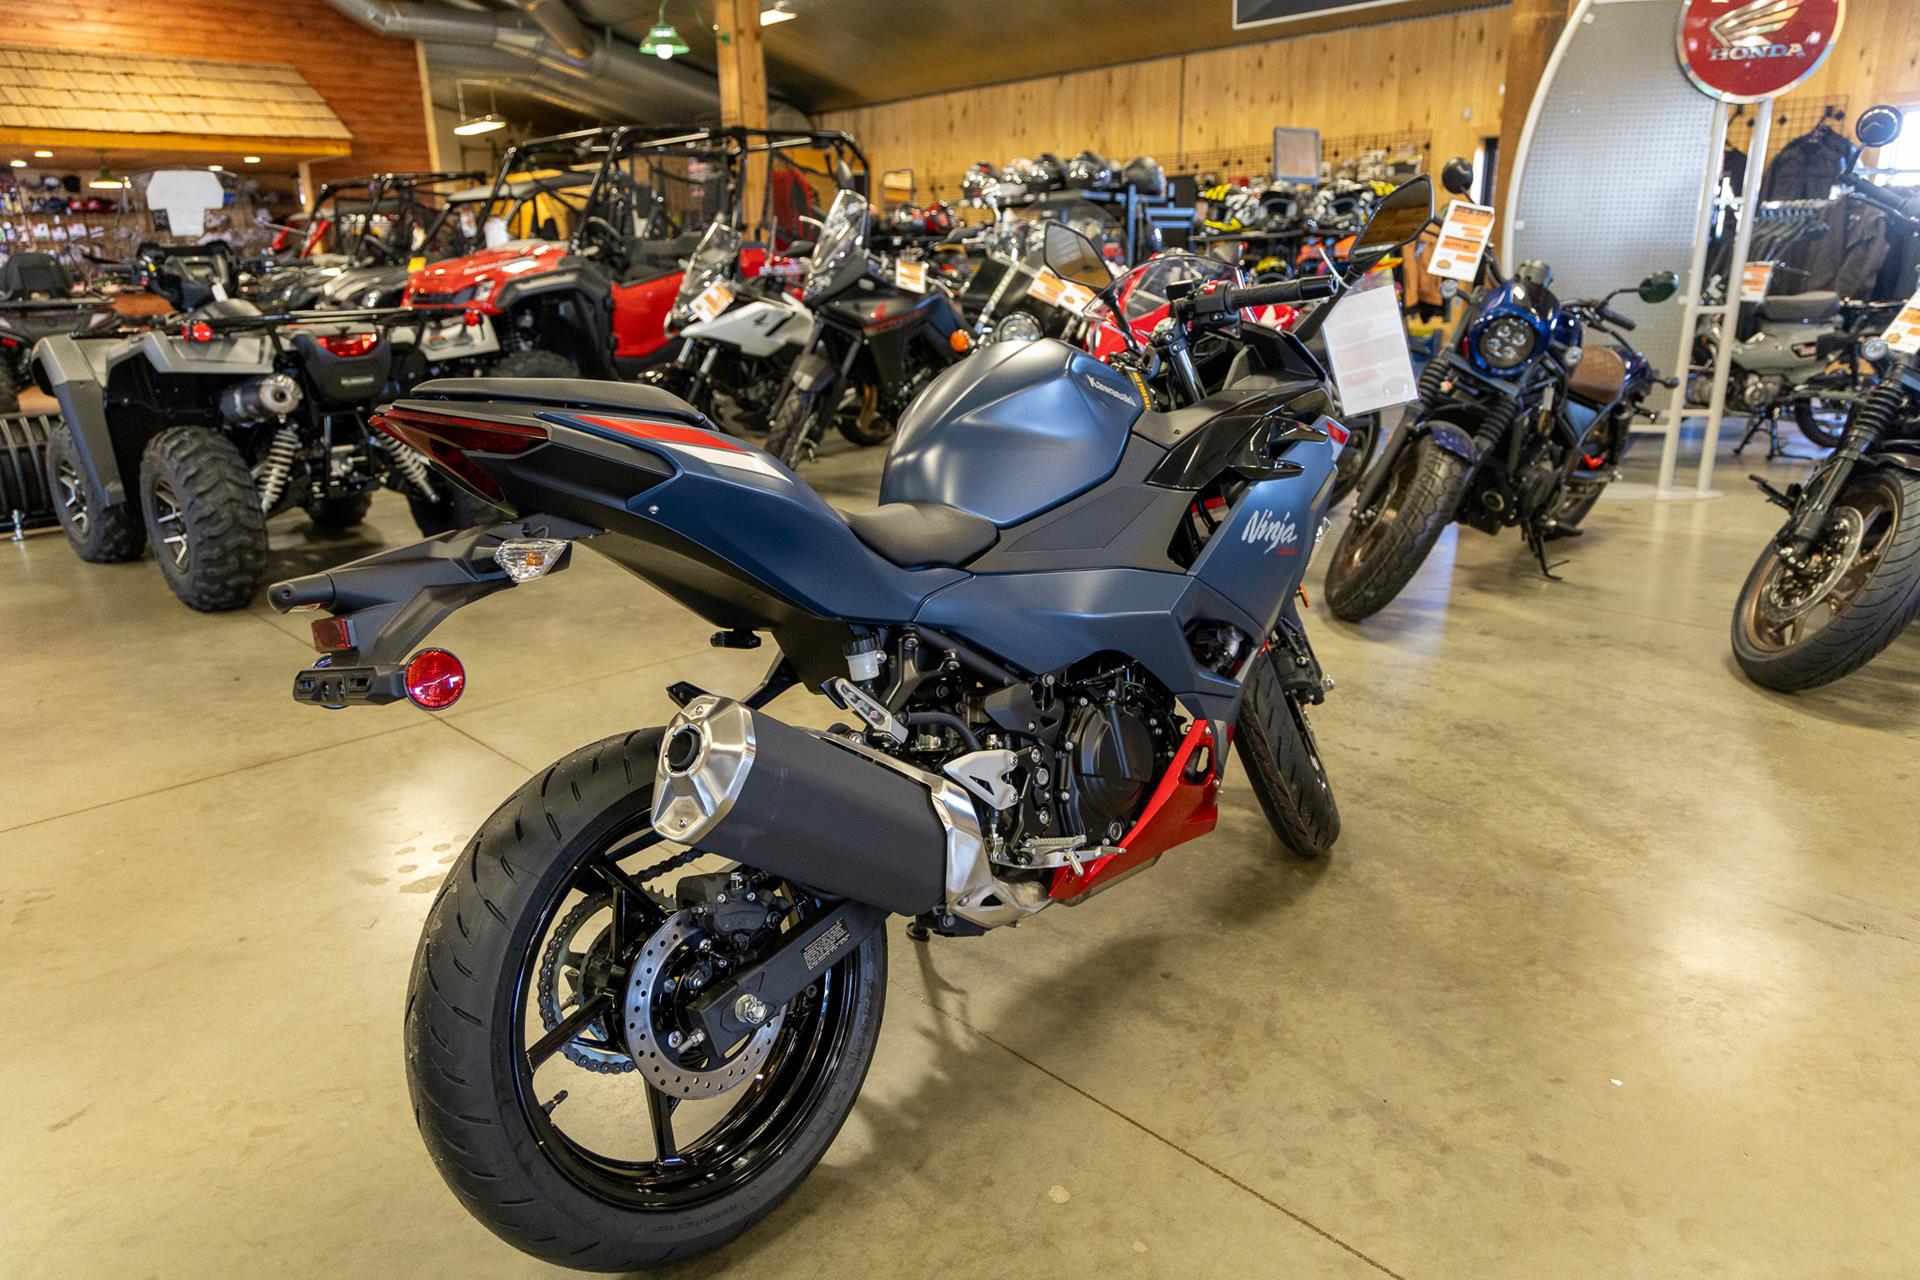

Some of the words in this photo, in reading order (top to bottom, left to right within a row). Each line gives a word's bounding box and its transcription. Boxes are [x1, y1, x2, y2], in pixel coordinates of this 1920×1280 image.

[1709, 43, 1805, 61] HONDA
[1086, 373, 1137, 408] Kawasaki
[1241, 508, 1298, 554] Ninja
